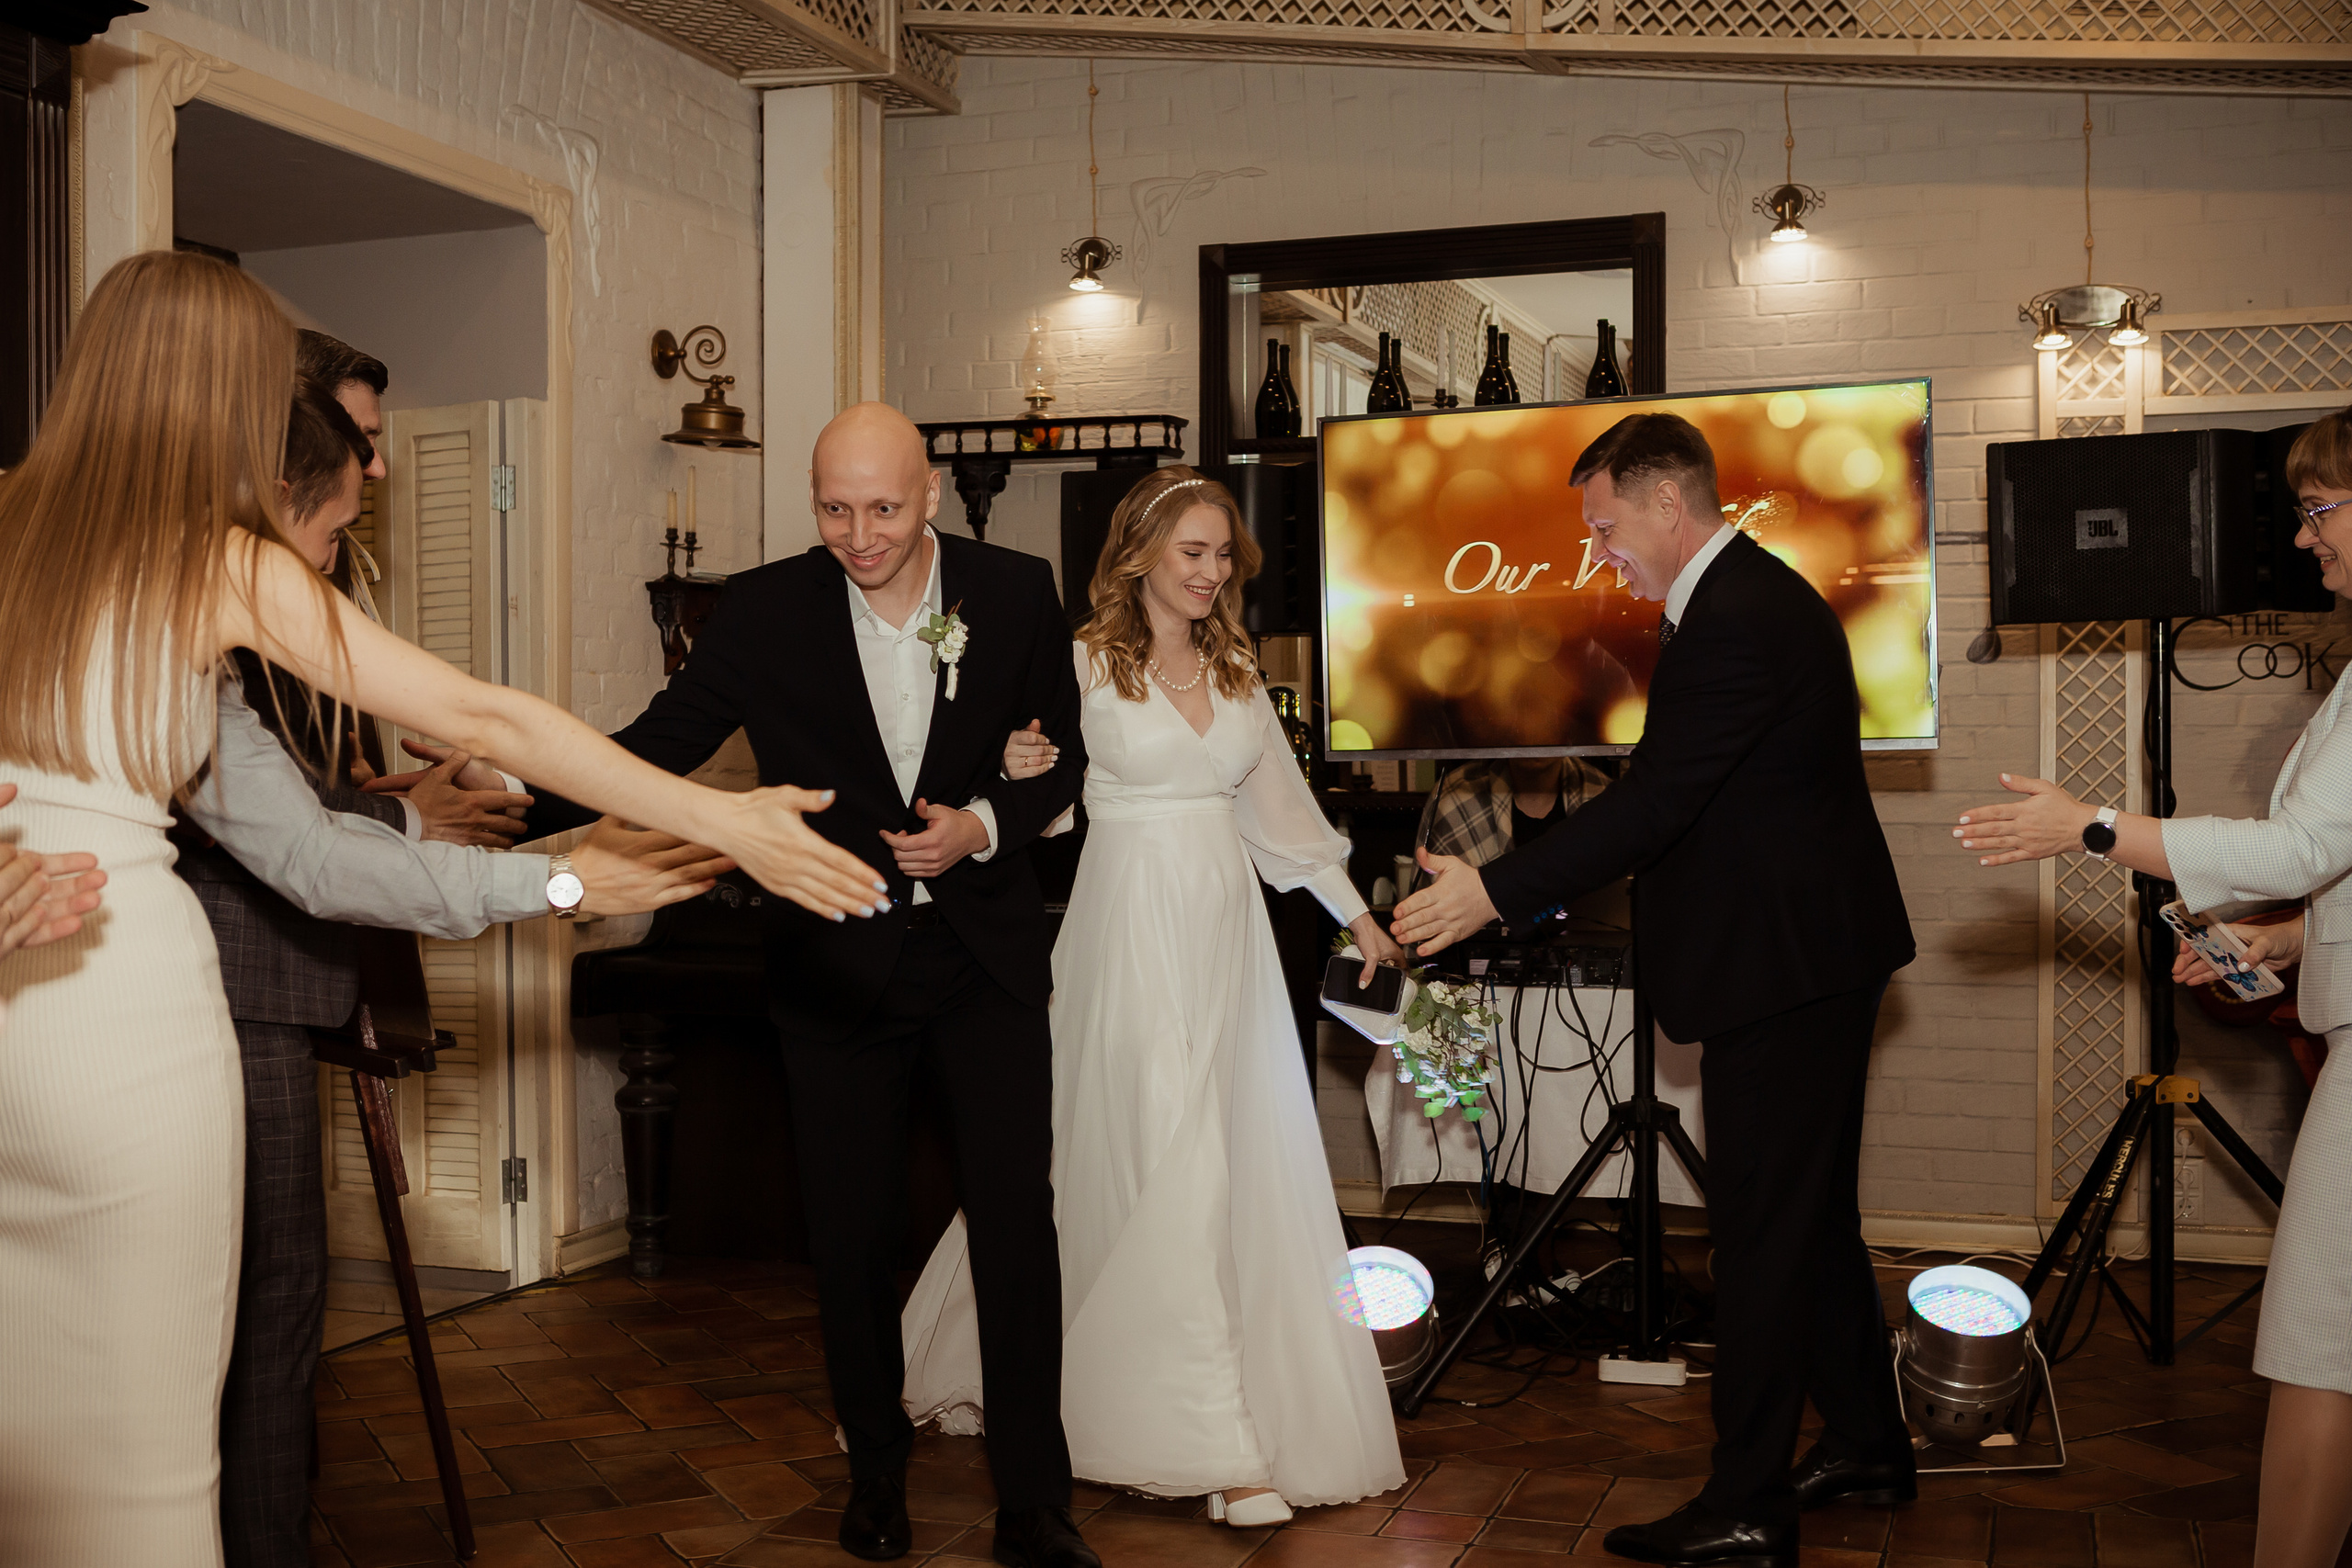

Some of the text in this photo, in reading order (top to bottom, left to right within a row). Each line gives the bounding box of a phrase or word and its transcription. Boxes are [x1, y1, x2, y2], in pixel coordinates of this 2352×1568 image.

[2087, 519, 2119, 537] JBL
[1443, 540, 1551, 594] Our
[2236, 613, 2290, 636] THE
[2170, 615, 2338, 691] COOK
[2102, 1139, 2134, 1199] HERCULES
